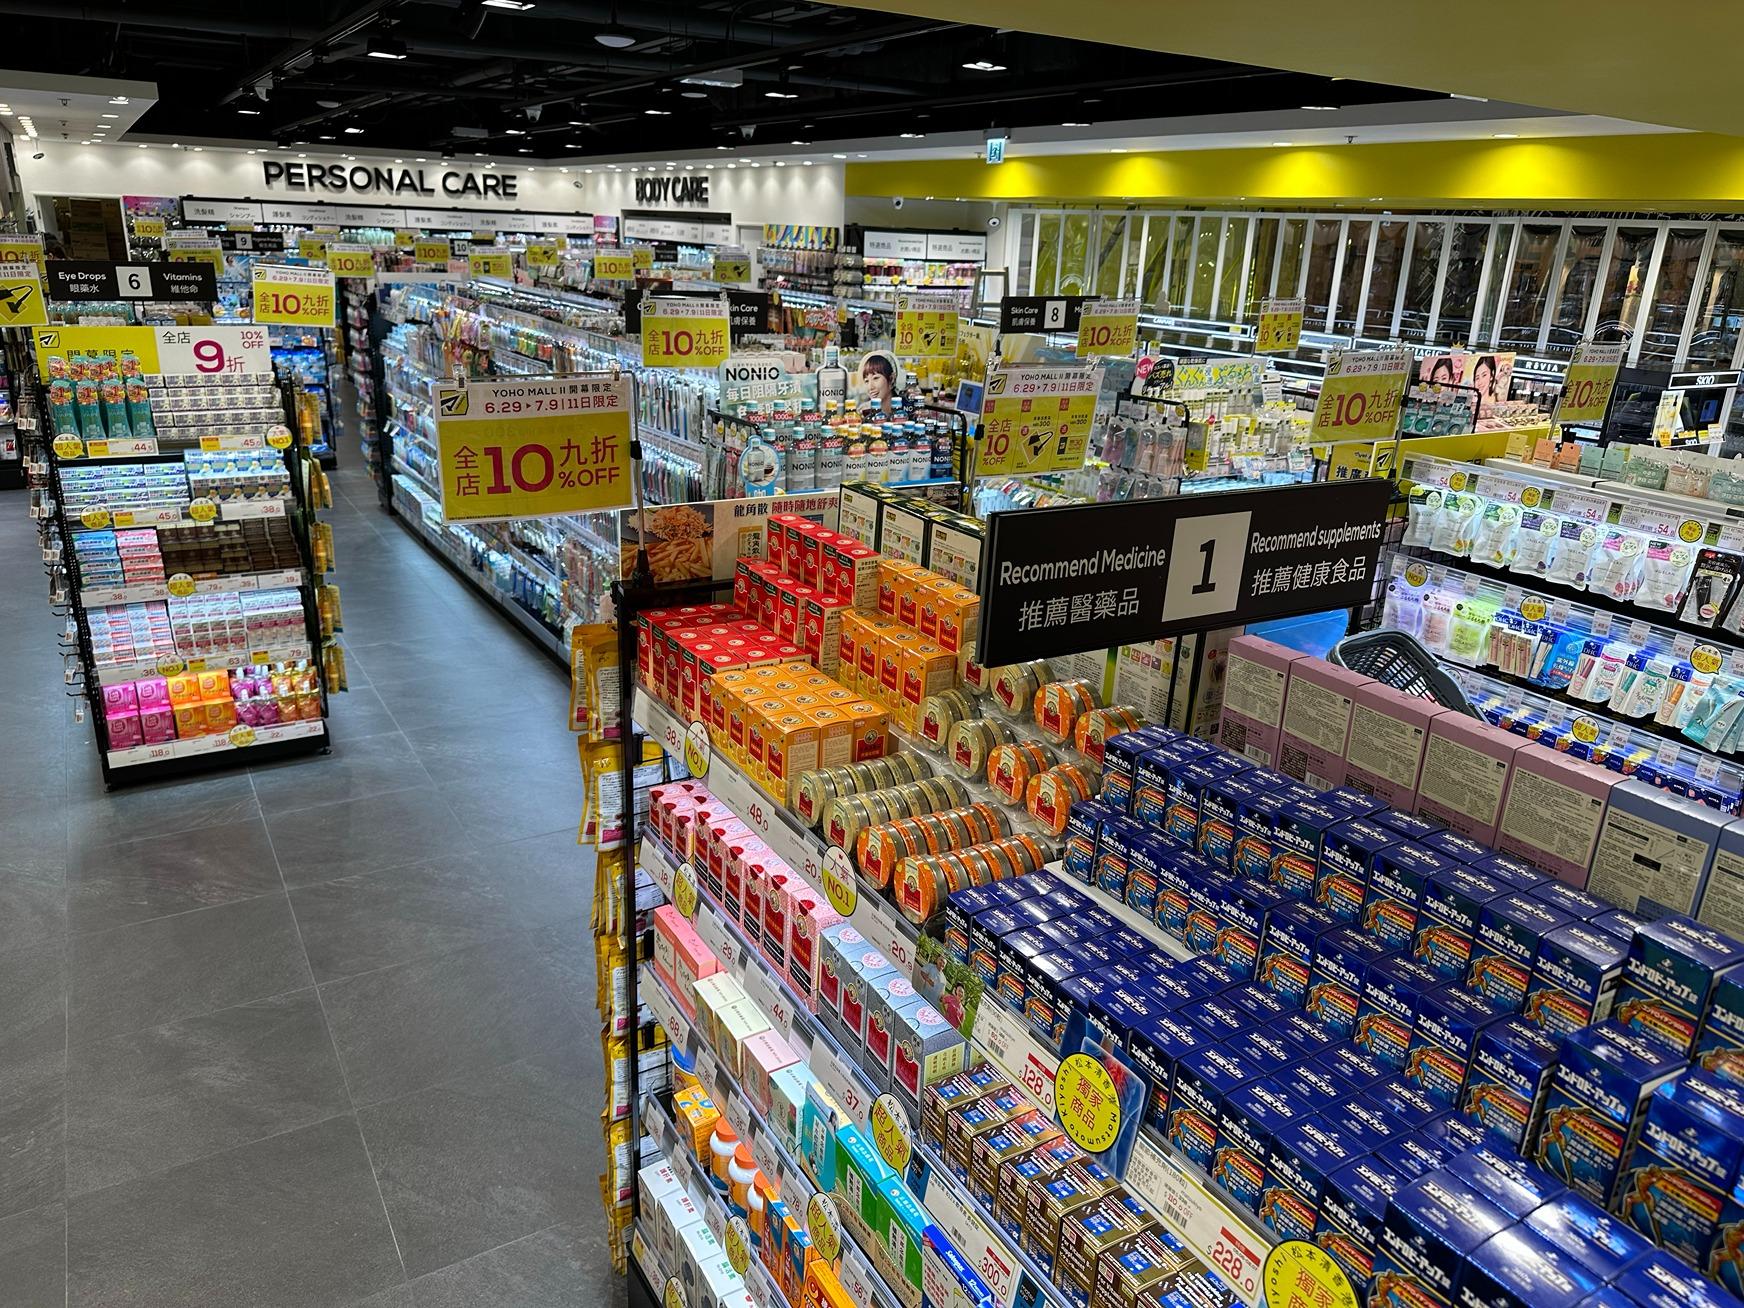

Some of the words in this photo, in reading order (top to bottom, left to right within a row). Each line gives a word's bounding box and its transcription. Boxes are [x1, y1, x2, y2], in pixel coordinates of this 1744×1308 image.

[263, 161, 435, 193] PERSONAL
[442, 171, 518, 197] CARE
[635, 177, 671, 201] BODY
[671, 176, 709, 201] CARE
[240, 237, 247, 246] 9
[457, 243, 467, 252] 10
[337, 258, 354, 271] 10
[59, 272, 76, 281] Eye
[77, 272, 107, 282] Drops
[128, 274, 141, 290] 6
[163, 272, 203, 281] Vitamins
[271, 293, 301, 315] 10
[303, 293, 330, 307] 九折
[1011, 306, 1024, 314] Skin
[1051, 307, 1059, 322] 8
[162, 331, 191, 344] 全店
[240, 331, 263, 341] 10%
[696, 330, 723, 344] 九折
[900, 331, 913, 344] 10
[1088, 326, 1111, 346] 10
[1112, 324, 1133, 336] 九折
[242, 340, 264, 350] OFF
[662, 330, 693, 356] 10
[695, 345, 724, 355] %OFF
[193, 340, 225, 373] 9
[226, 355, 245, 373] 折
[725, 366, 779, 382] NONIO
[1136, 363, 1154, 374] NEW
[1346, 364, 1361, 373] 6.29
[492, 388, 524, 398] YOHO
[528, 387, 556, 396] MALL
[569, 382, 612, 394] 開幕限定
[819, 388, 845, 397] NONIO
[1013, 383, 1036, 393] 6.29
[1043, 383, 1056, 392] 7.9
[1567, 380, 1593, 409] 10
[485, 401, 522, 414] 6.29
[535, 399, 558, 411] 7.9
[568, 395, 619, 409] 11日限定
[1368, 388, 1398, 409] 九折
[1332, 393, 1365, 427] 10
[1365, 409, 1394, 424] %OFF
[988, 419, 1012, 433] 全店
[560, 435, 619, 468] 九折
[984, 433, 1010, 456] 10
[483, 443, 554, 495] 10
[982, 457, 1006, 466] %OFF
[454, 445, 481, 497] 全店
[558, 466, 620, 489] %OFF
[1250, 530, 1318, 555] Recommend
[1317, 520, 1382, 546] supplements
[1000, 550, 1098, 587] Recommend
[1101, 545, 1166, 575] Medicine
[1191, 538, 1218, 595] 1
[1251, 556, 1367, 597] 推薦健康食品
[1018, 587, 1140, 632] 推薦醫藥品
[1670, 672, 1688, 681] DHC
[687, 744, 703, 772] NO.1
[827, 878, 850, 909] NO.1
[1070, 1095, 1096, 1132] 商品
[1207, 1240, 1254, 1294] $228.0
[1272, 1252, 1288, 1305] iyoshi
